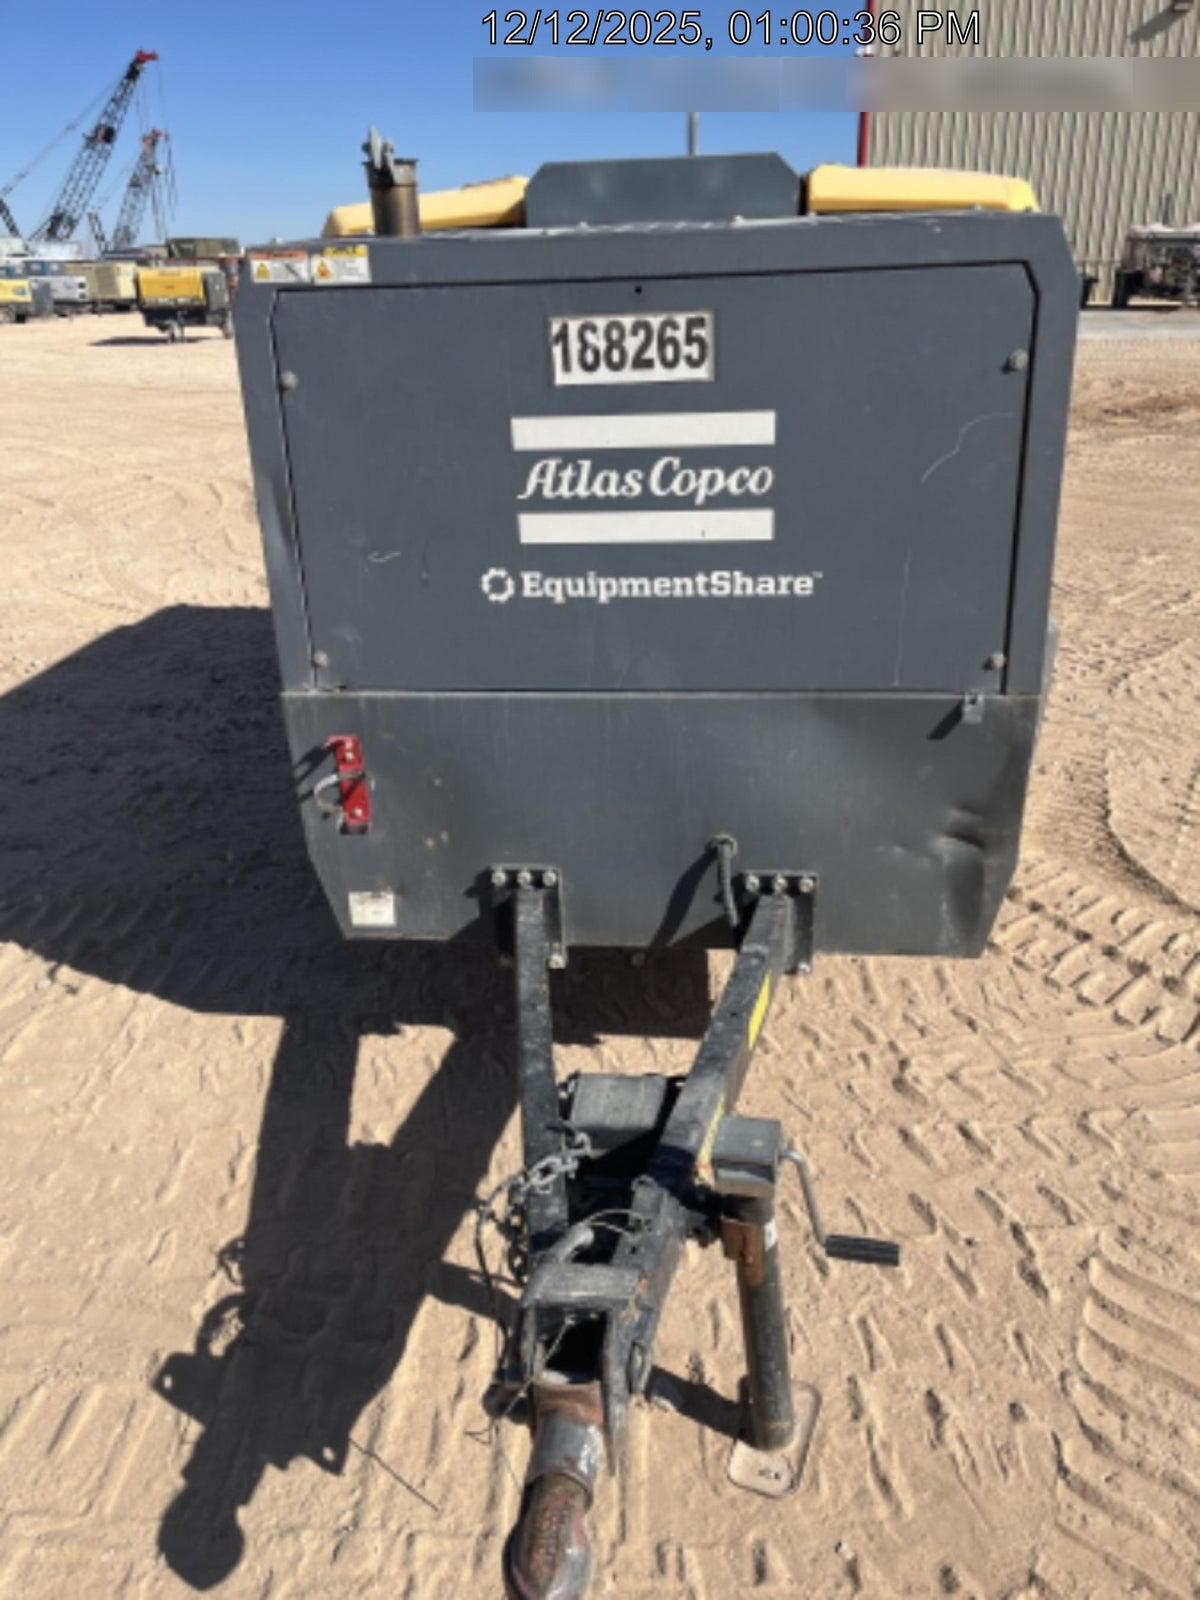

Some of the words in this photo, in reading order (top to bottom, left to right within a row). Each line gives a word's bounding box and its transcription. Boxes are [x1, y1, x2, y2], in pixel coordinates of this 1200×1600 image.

[516, 457, 644, 500] Atlas
[649, 456, 775, 506] Copco
[520, 570, 815, 604] EquipmentShare
